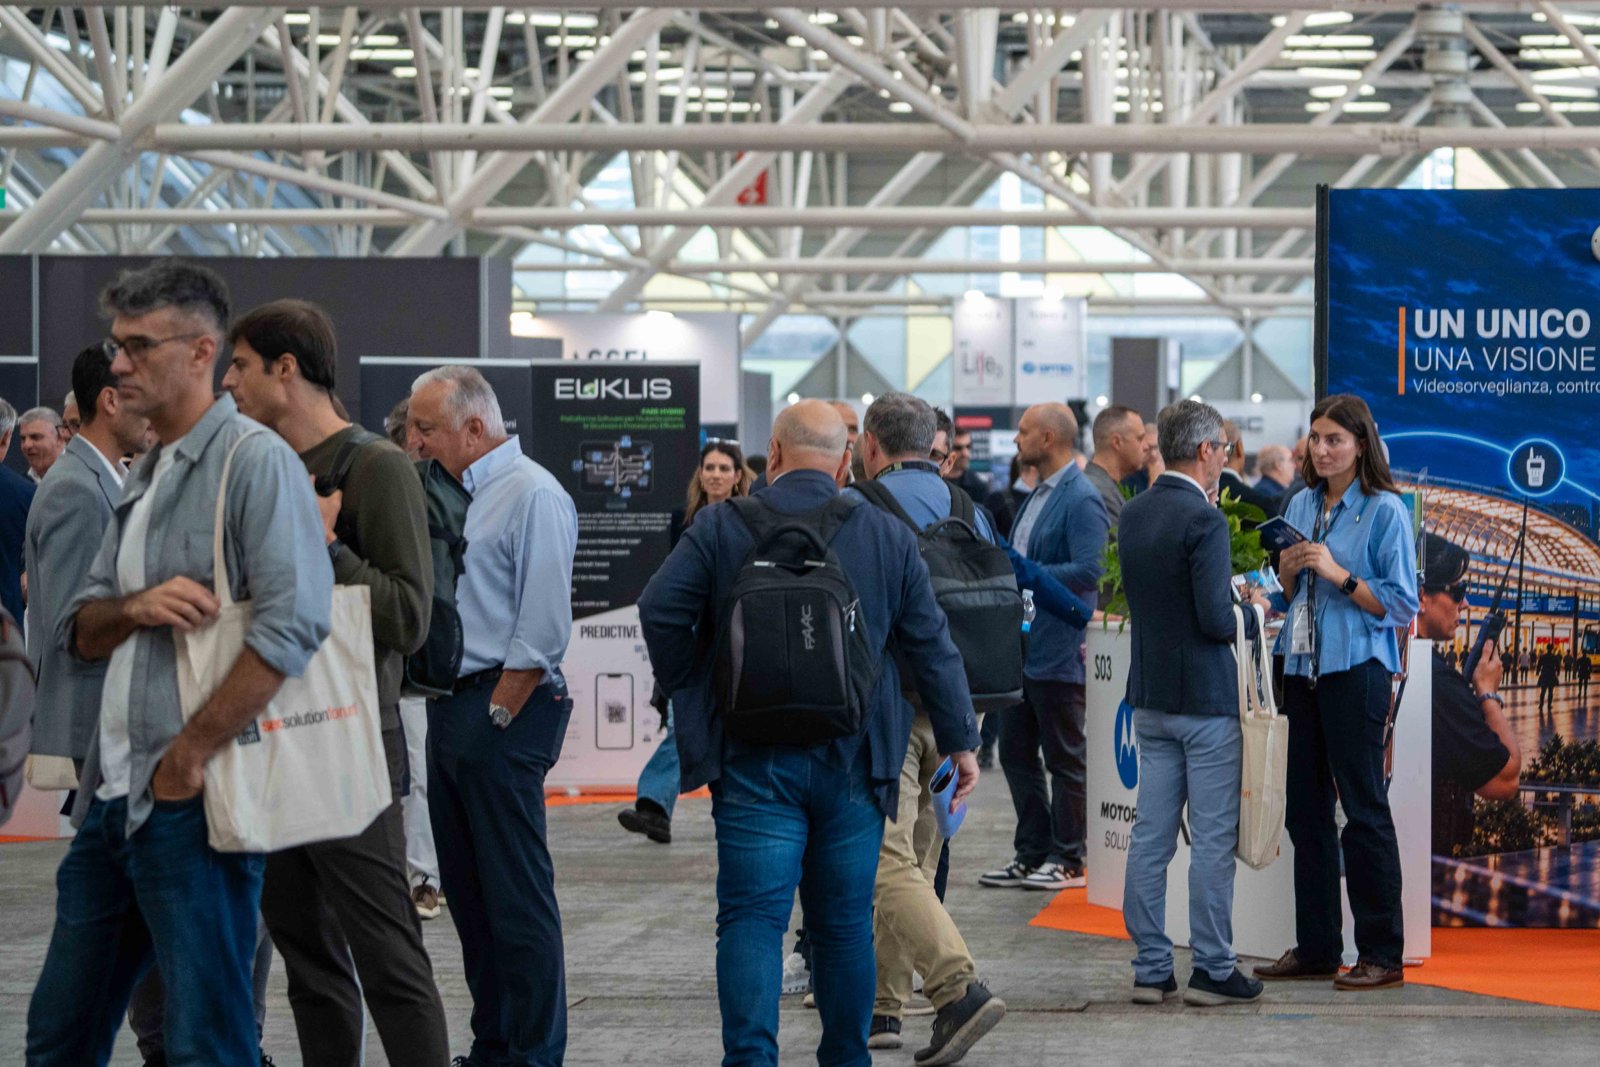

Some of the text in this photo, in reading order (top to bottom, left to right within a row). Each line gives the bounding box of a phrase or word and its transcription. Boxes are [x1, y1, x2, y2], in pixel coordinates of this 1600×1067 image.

[1414, 308, 1591, 339] UN UNICO
[1414, 346, 1596, 371] UNA VISIONE
[555, 378, 672, 400] EUKLIS
[1413, 378, 1552, 396] Videosorveglianza,
[580, 624, 639, 639] PREDICTIVE
[1094, 653, 1112, 681] S03
